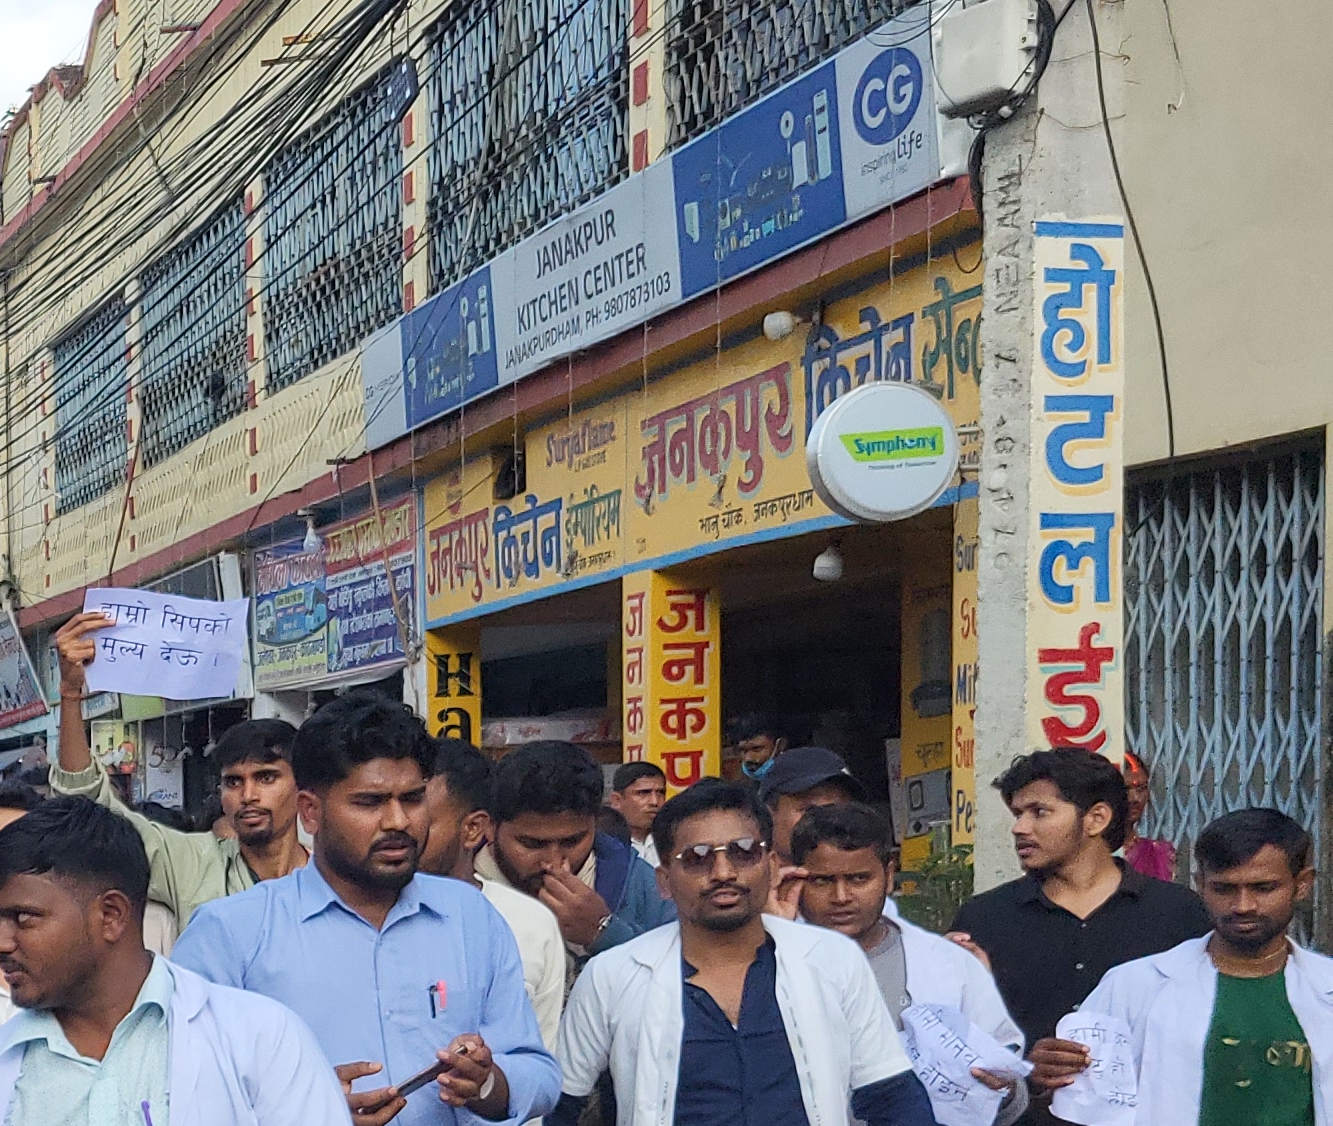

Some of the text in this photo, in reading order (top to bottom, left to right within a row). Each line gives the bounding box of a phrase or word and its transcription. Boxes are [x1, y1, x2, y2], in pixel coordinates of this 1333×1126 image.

[861, 64, 914, 129] CG
[897, 130, 923, 160] life
[536, 208, 617, 279] JANAKPUR
[505, 271, 671, 370] JANAKPURDHAM, PH: 9807873103
[517, 242, 647, 335] KITCHEN CENTER
[635, 361, 793, 493] जनकपुर
[854, 433, 938, 456] Symphony
[428, 507, 490, 602] जनकपुर
[493, 494, 563, 589] किचेन
[100, 637, 148, 663] मुल्य
[161, 604, 233, 635] सिपको
